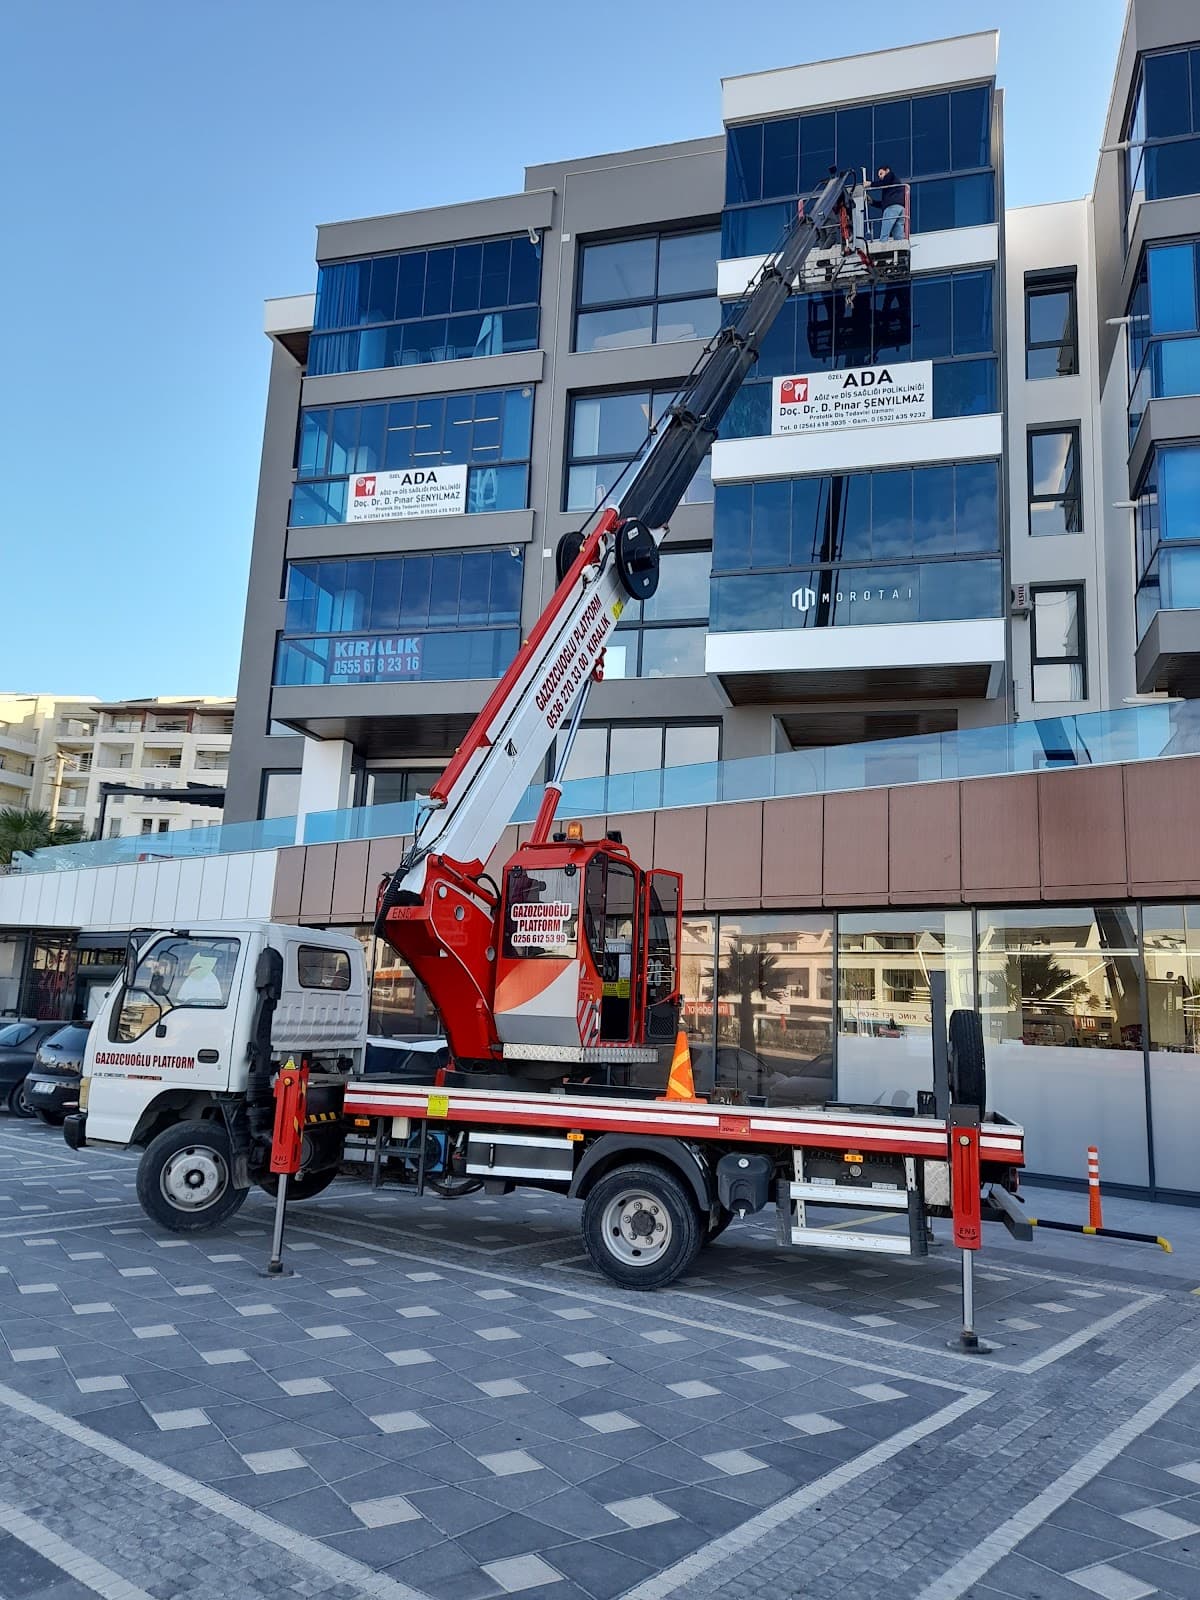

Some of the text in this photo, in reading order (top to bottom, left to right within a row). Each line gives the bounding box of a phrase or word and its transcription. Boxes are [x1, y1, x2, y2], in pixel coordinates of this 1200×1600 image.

[842, 369, 893, 389] ADA
[814, 393, 830, 402] AĞIZ
[852, 387, 881, 398] SAĞLIĞI
[882, 383, 925, 395] POLİKLİNİĞİ
[779, 393, 925, 416] Doç. Dr. D. Pınar ŞENYILMAZ
[401, 471, 437, 486] ADA
[371, 498, 382, 506] Dr.
[384, 497, 392, 505] D.
[416, 491, 460, 503] ŞENYILMAZ
[822, 588, 912, 604] MOROTAI
[574, 593, 602, 646] PLATFORM
[334, 659, 361, 675] 0555
[387, 657, 401, 672] 23
[406, 656, 419, 670] 16
[546, 698, 564, 730] 0536
[560, 680, 575, 704] 270
[570, 665, 582, 685] 33
[579, 652, 589, 672] 00
[513, 903, 570, 918] GAZOZCUOĞLU
[519, 920, 561, 932] PLATFORM
[513, 934, 566, 943] 0256 612 53 99
[95, 1051, 195, 1069] GAZOZCUOĞLU PLATFORM
